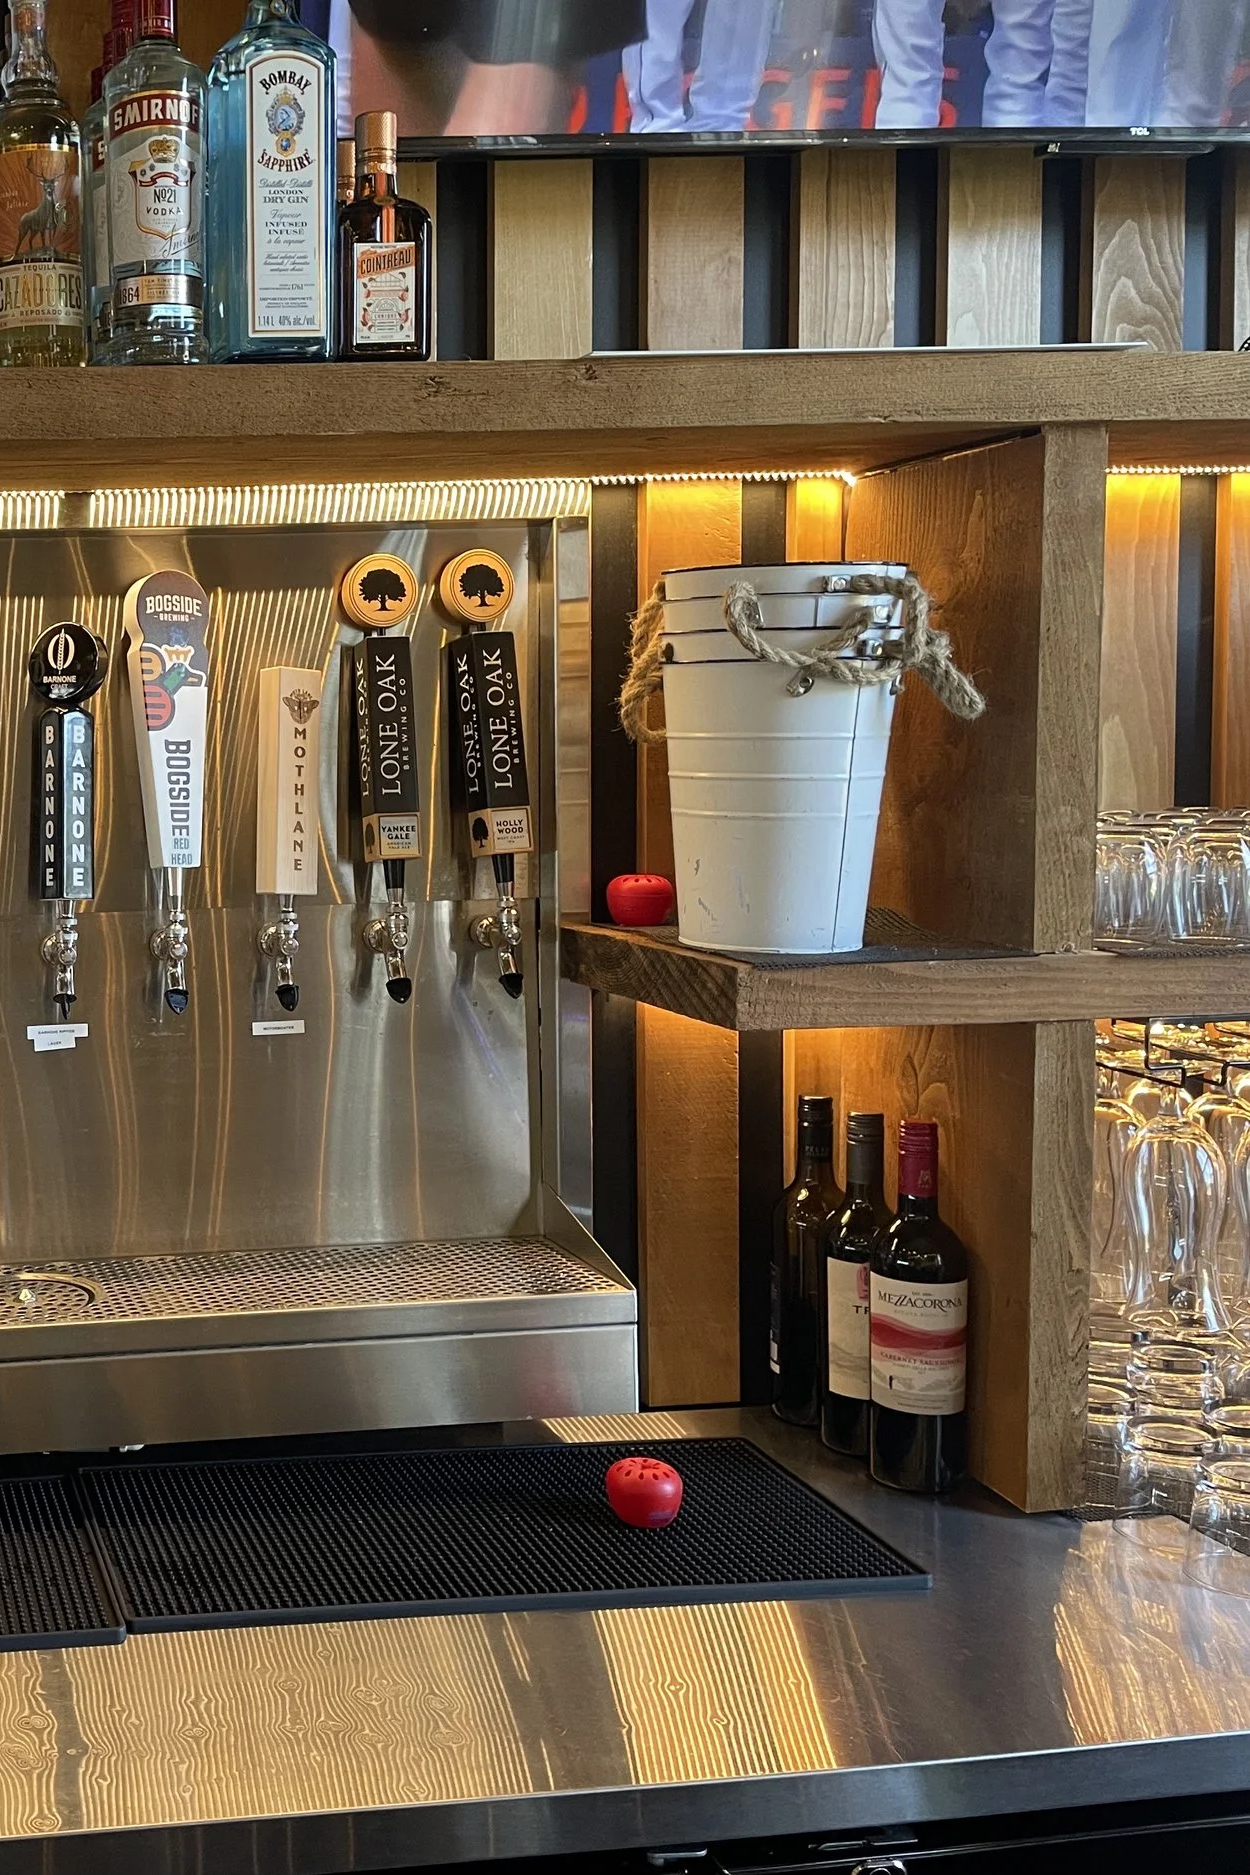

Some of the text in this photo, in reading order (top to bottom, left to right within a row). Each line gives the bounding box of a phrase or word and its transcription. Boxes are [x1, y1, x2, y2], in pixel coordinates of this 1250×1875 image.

[259, 70, 312, 95] BOMBAY
[114, 99, 199, 130] SMIRNOF
[1130, 127, 1150, 136] TCL
[257, 148, 314, 172] SAPPHIRE
[146, 206, 183, 216] VODKA
[360, 249, 411, 274] COINTREAU
[119, 286, 140, 304] 1864
[258, 316, 270, 326] 1.14
[279, 315, 291, 326] 40%
[145, 594, 202, 616] BOGSIDE
[159, 613, 189, 622] BREWING
[43, 675, 77, 683] BARNONE
[356, 658, 367, 716] OAK
[375, 653, 402, 796] LONE OAK
[399, 678, 410, 770] BREWING CO
[456, 653, 479, 794] LONE OAK
[482, 648, 513, 789] LONE OAK
[506, 672, 520, 764] BREWING CO
[359, 726, 369, 796] LONE
[164, 739, 191, 836] BOGSIDE
[293, 727, 307, 871] MOTHLANE
[45, 725, 55, 887] BARNONE
[72, 725, 86, 887] BARNONE
[381, 825, 416, 833] YANKEE
[496, 819, 524, 828] HOLLY
[497, 826, 524, 834] WOOD
[174, 838, 189, 849] RED
[171, 853, 193, 865] HEAD
[878, 1291, 962, 1312] MEZZACORONA
[880, 1352, 917, 1365] CABERNET
